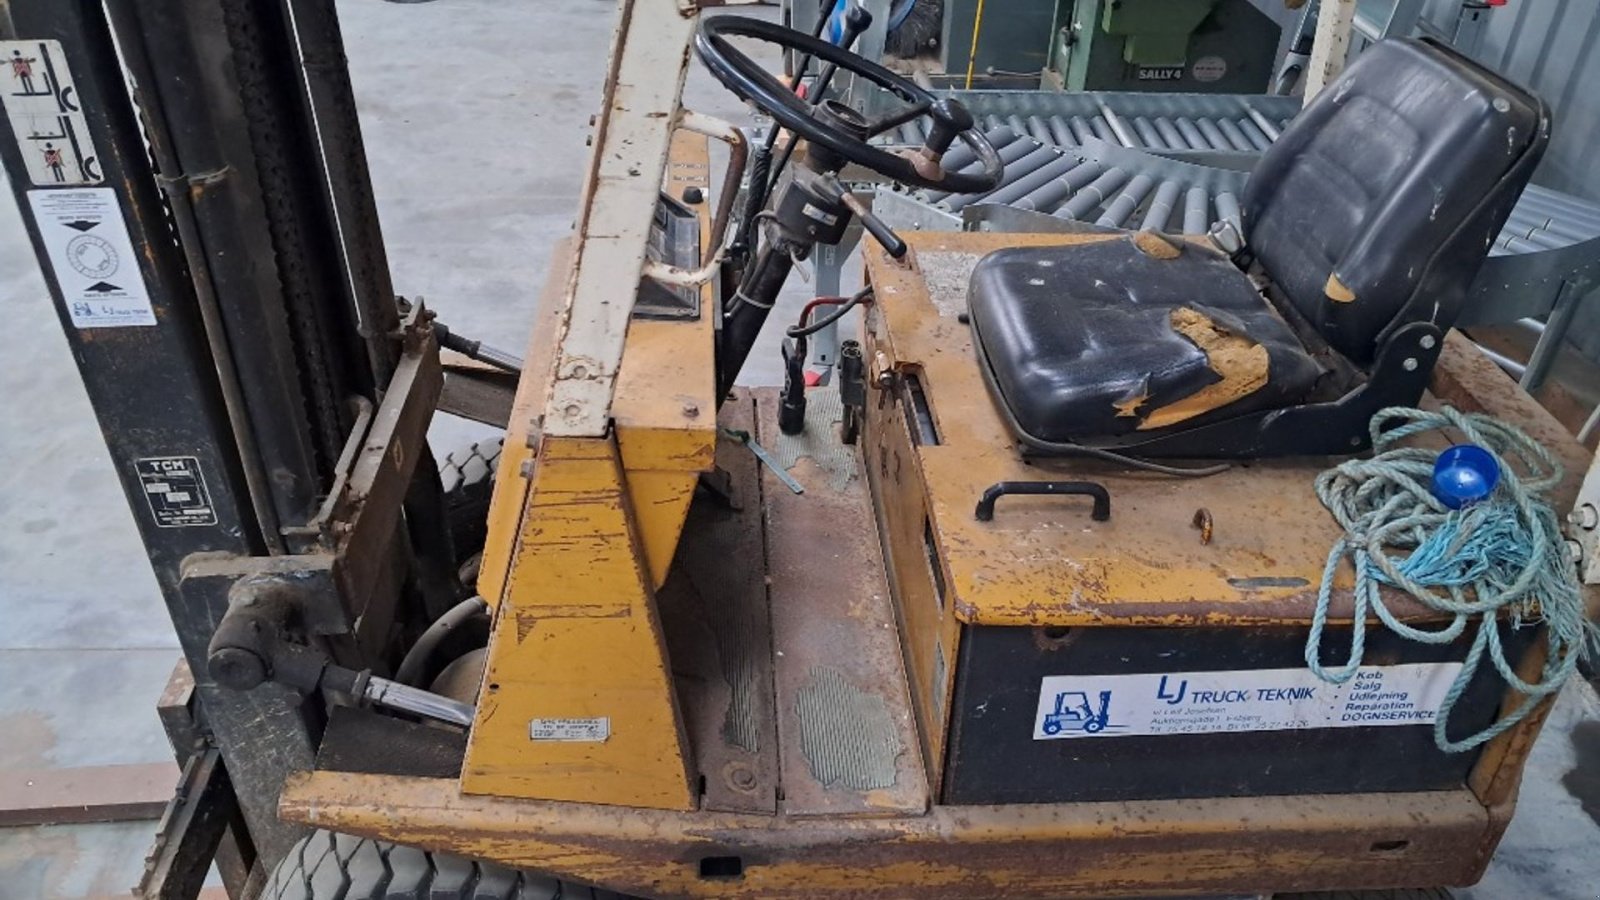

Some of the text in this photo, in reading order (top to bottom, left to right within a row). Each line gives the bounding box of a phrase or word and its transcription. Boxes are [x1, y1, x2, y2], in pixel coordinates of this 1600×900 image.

[1139, 69, 1173, 79] SALLY
[150, 460, 186, 471] TCM
[1157, 675, 1316, 705] LJ TRUCK TEKNIK
[1353, 681, 1382, 692] Salg
[1349, 692, 1407, 701] Udlejning
[1345, 702, 1414, 711] Reparation
